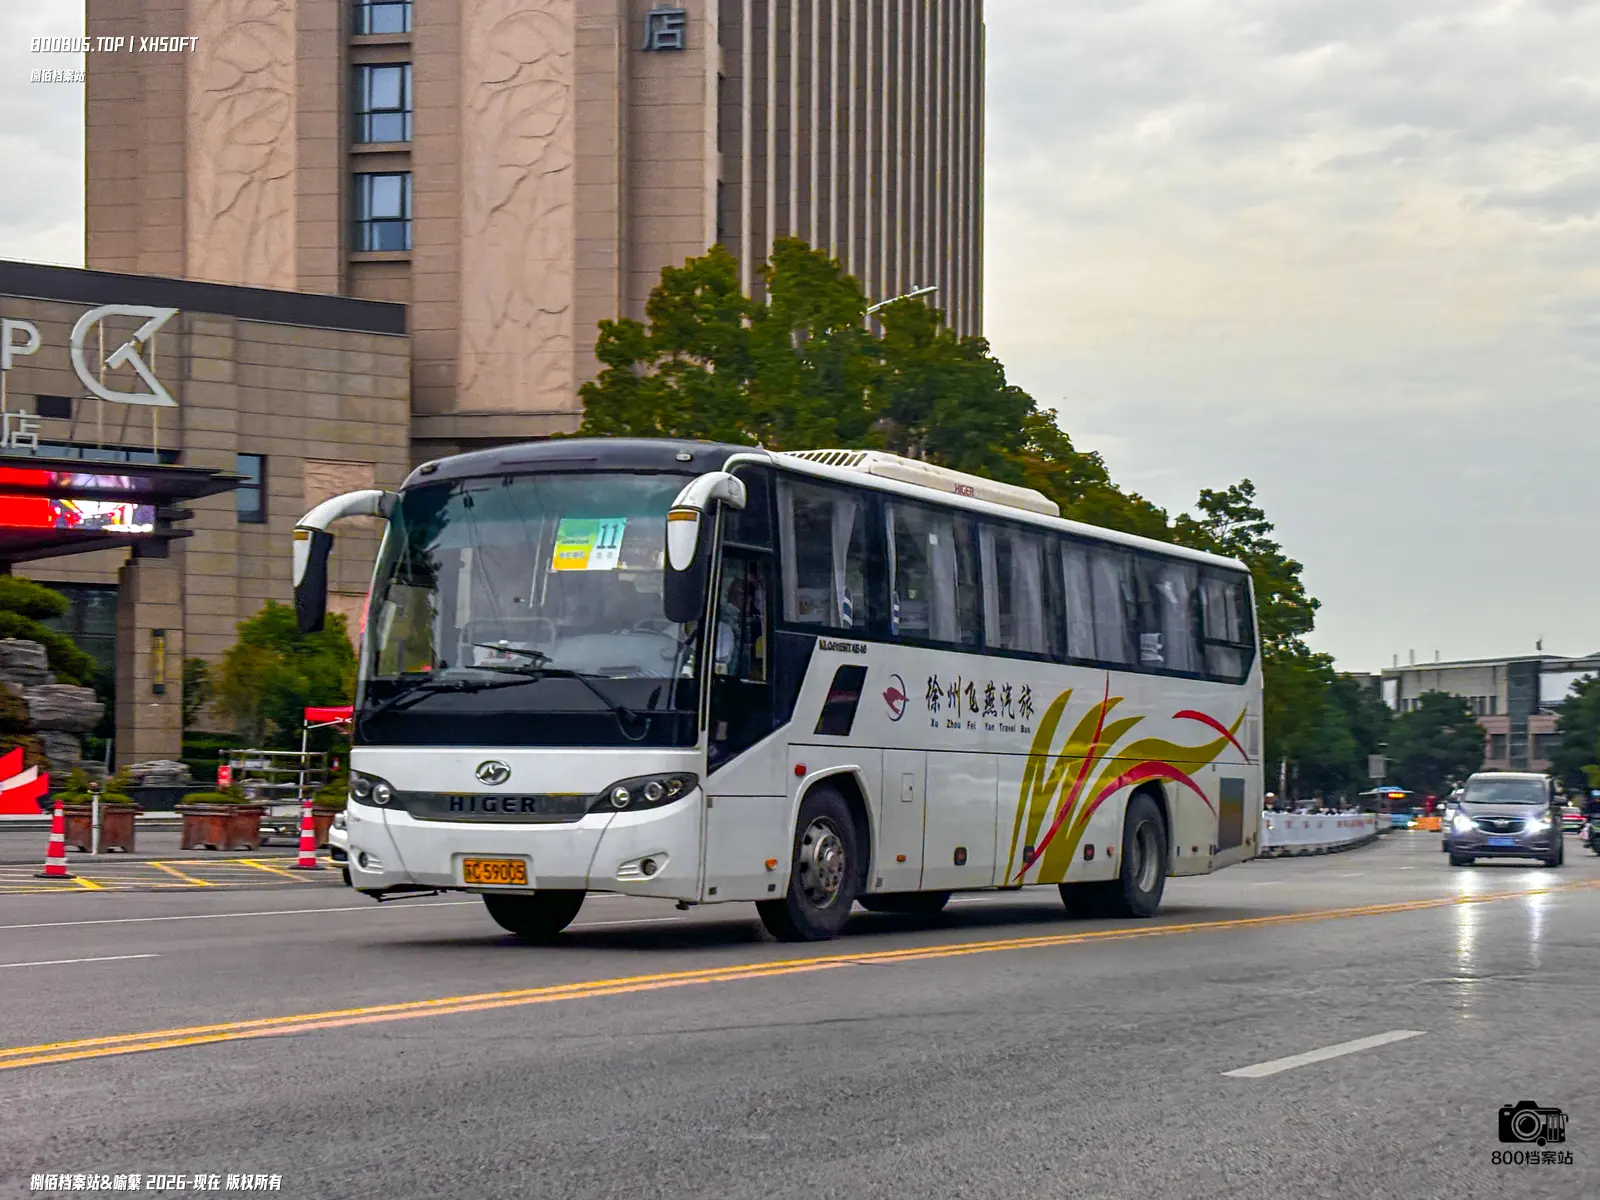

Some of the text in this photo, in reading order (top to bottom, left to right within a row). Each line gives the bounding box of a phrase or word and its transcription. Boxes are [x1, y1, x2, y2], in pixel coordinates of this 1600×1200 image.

[641, 8, 685, 49] 店
[954, 483, 975, 497] HIGER
[596, 524, 618, 549] 11
[926, 674, 1034, 720] 徐州飞燕汽旅
[930, 718, 1031, 734] Xu Zhou Fei Yan Travel Bus
[450, 796, 536, 813] HIGER
